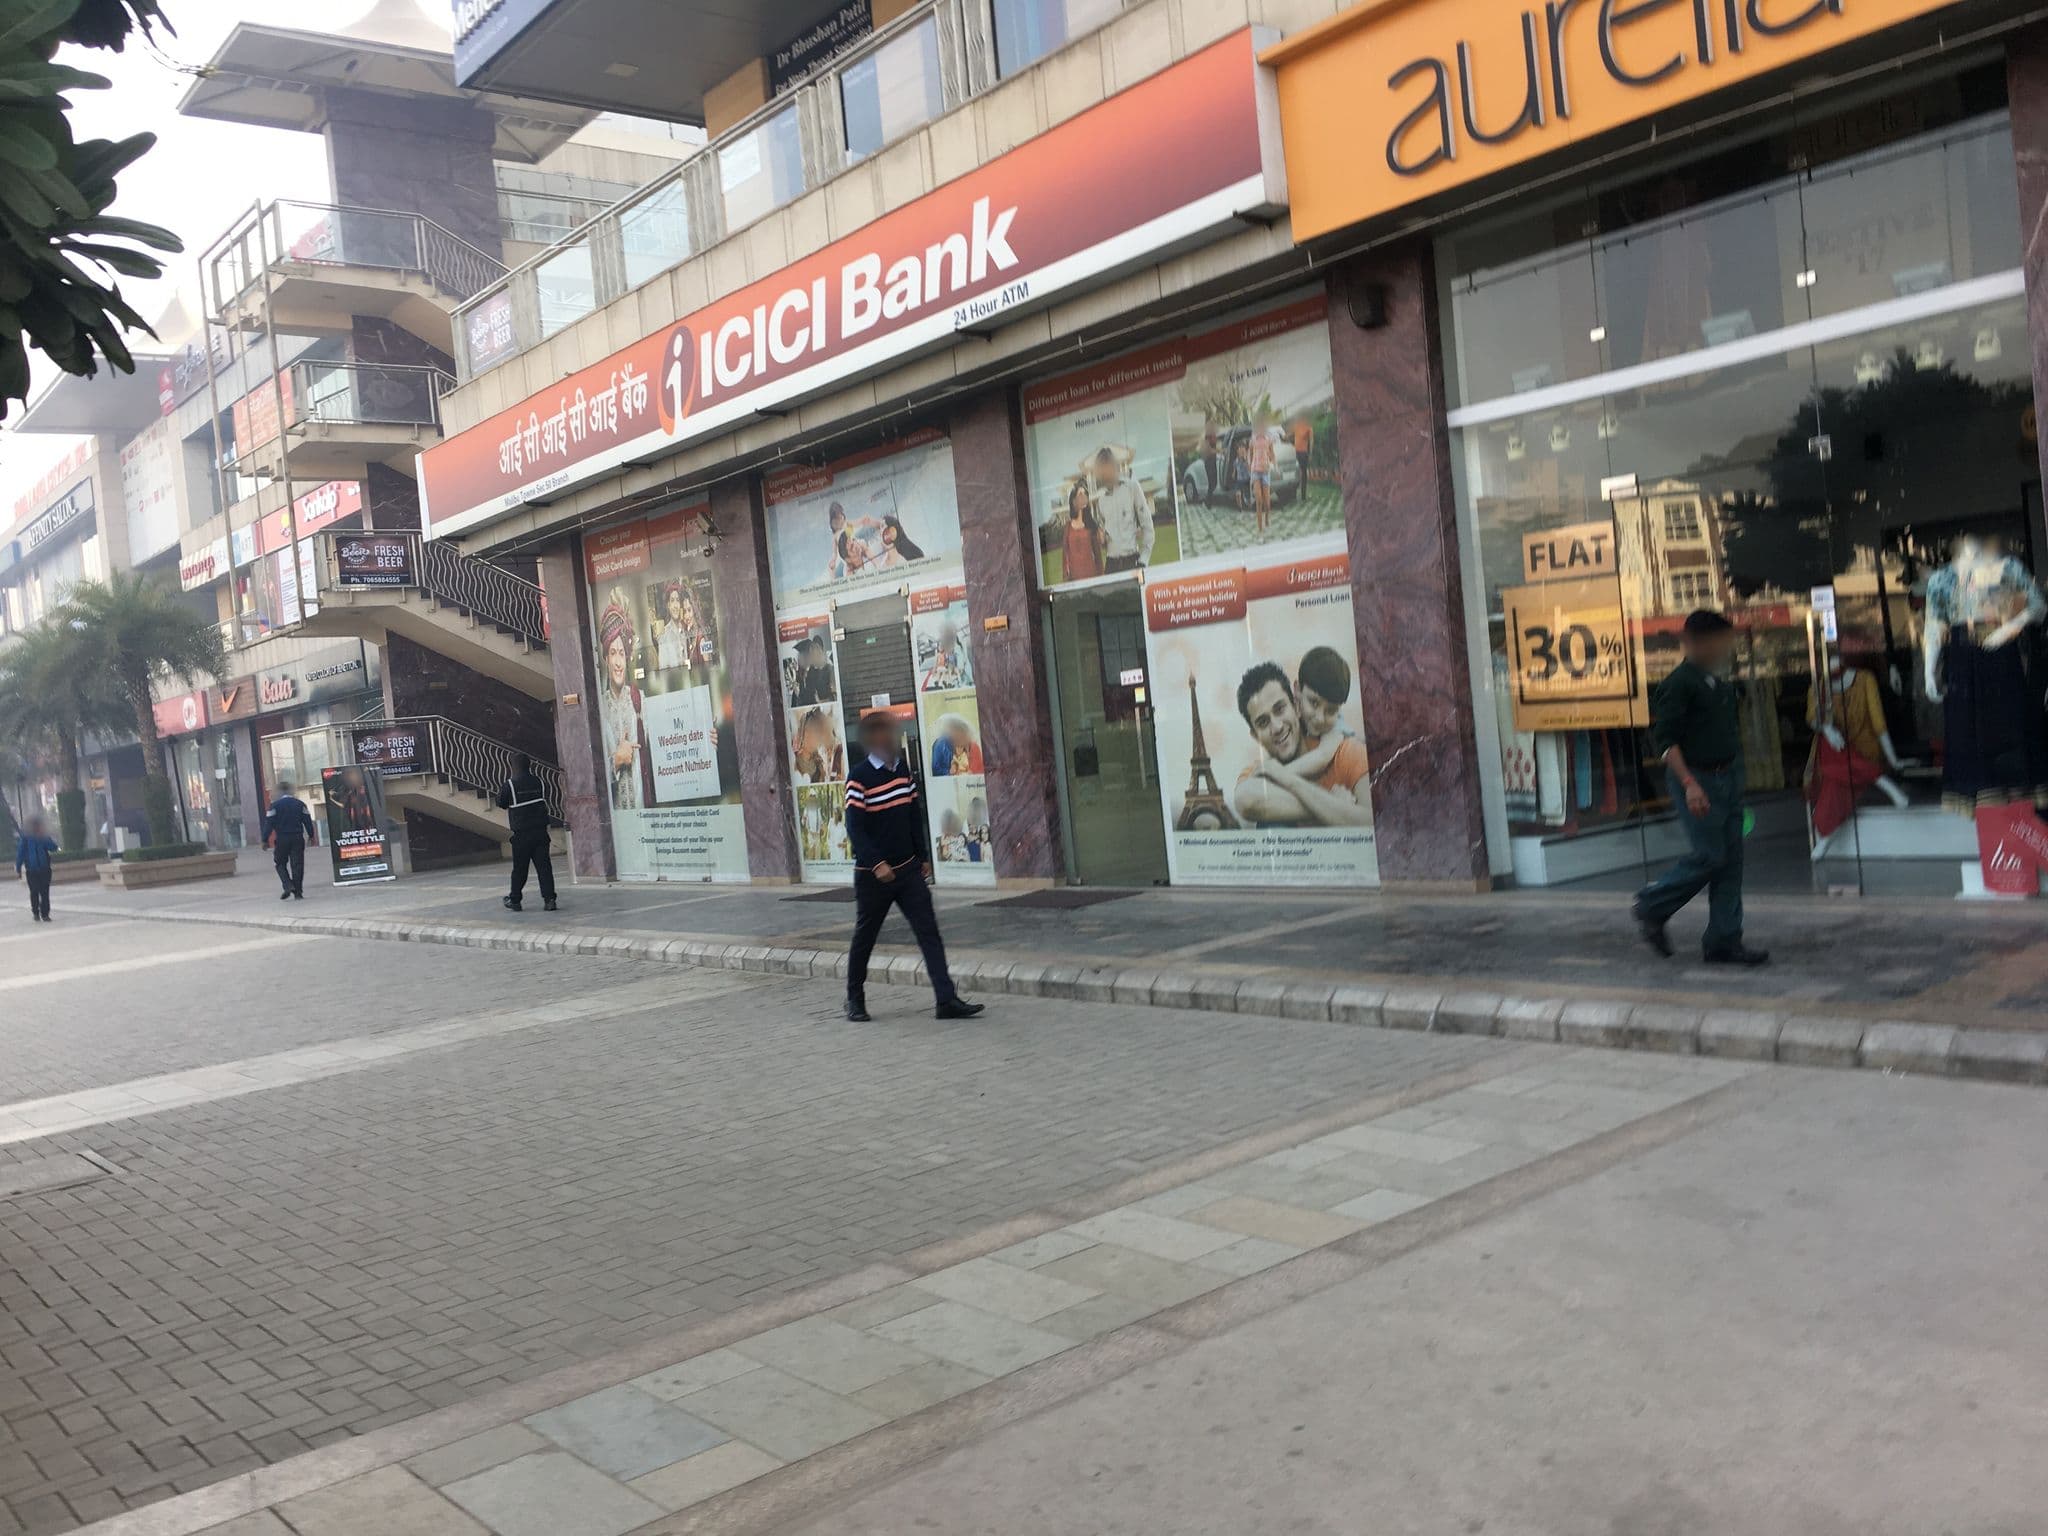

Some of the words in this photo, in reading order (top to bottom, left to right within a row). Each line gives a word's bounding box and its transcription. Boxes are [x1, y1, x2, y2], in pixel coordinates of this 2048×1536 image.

[1386, 0, 1846, 178] aure
[700, 277, 827, 398] ICICI
[840, 195, 1020, 340] Bank
[953, 306, 969, 327] 24
[969, 297, 999, 320] Hour
[1001, 281, 1031, 309] ATM
[1246, 364, 1268, 378] Loan
[1028, 391, 1068, 411] Different
[1069, 384, 1089, 400] loan
[1091, 379, 1105, 392] for
[1107, 364, 1151, 387] different
[1152, 352, 1183, 373] needs
[499, 418, 522, 476] आई
[523, 412, 541, 465] सी
[541, 397, 568, 457] आई
[568, 387, 587, 443] सी
[588, 371, 618, 434] आई
[620, 361, 649, 419] बैंक
[1075, 417, 1096, 430] Home
[1096, 411, 1115, 424] Loan
[552, 473, 569, 488] Branch
[374, 545, 405, 556] FRESH
[1529, 534, 1608, 573] FLAT
[377, 556, 404, 567] BEER
[1322, 565, 1344, 577] Bank
[1153, 586, 1171, 599] With
[1179, 580, 1211, 596] Personal
[1157, 599, 1176, 611] took
[1183, 595, 1208, 608] dream
[1209, 590, 1238, 607] holiday
[1295, 593, 1329, 609] Personal
[1330, 591, 1350, 604] Loan
[1524, 624, 1598, 681] 30
[673, 718, 685, 731] My
[387, 736, 415, 749] FRESH
[657, 732, 688, 748] Wedding
[688, 730, 704, 742] date
[390, 747, 415, 759] BEER
[673, 749, 687, 760] now
[688, 747, 699, 758] my
[657, 764, 684, 776] Account
[685, 759, 712, 772] Number
[335, 838, 358, 846] YOUR
[359, 834, 385, 844] STYLE
[341, 830, 365, 838] SPICE
[366, 829, 377, 837] UP
